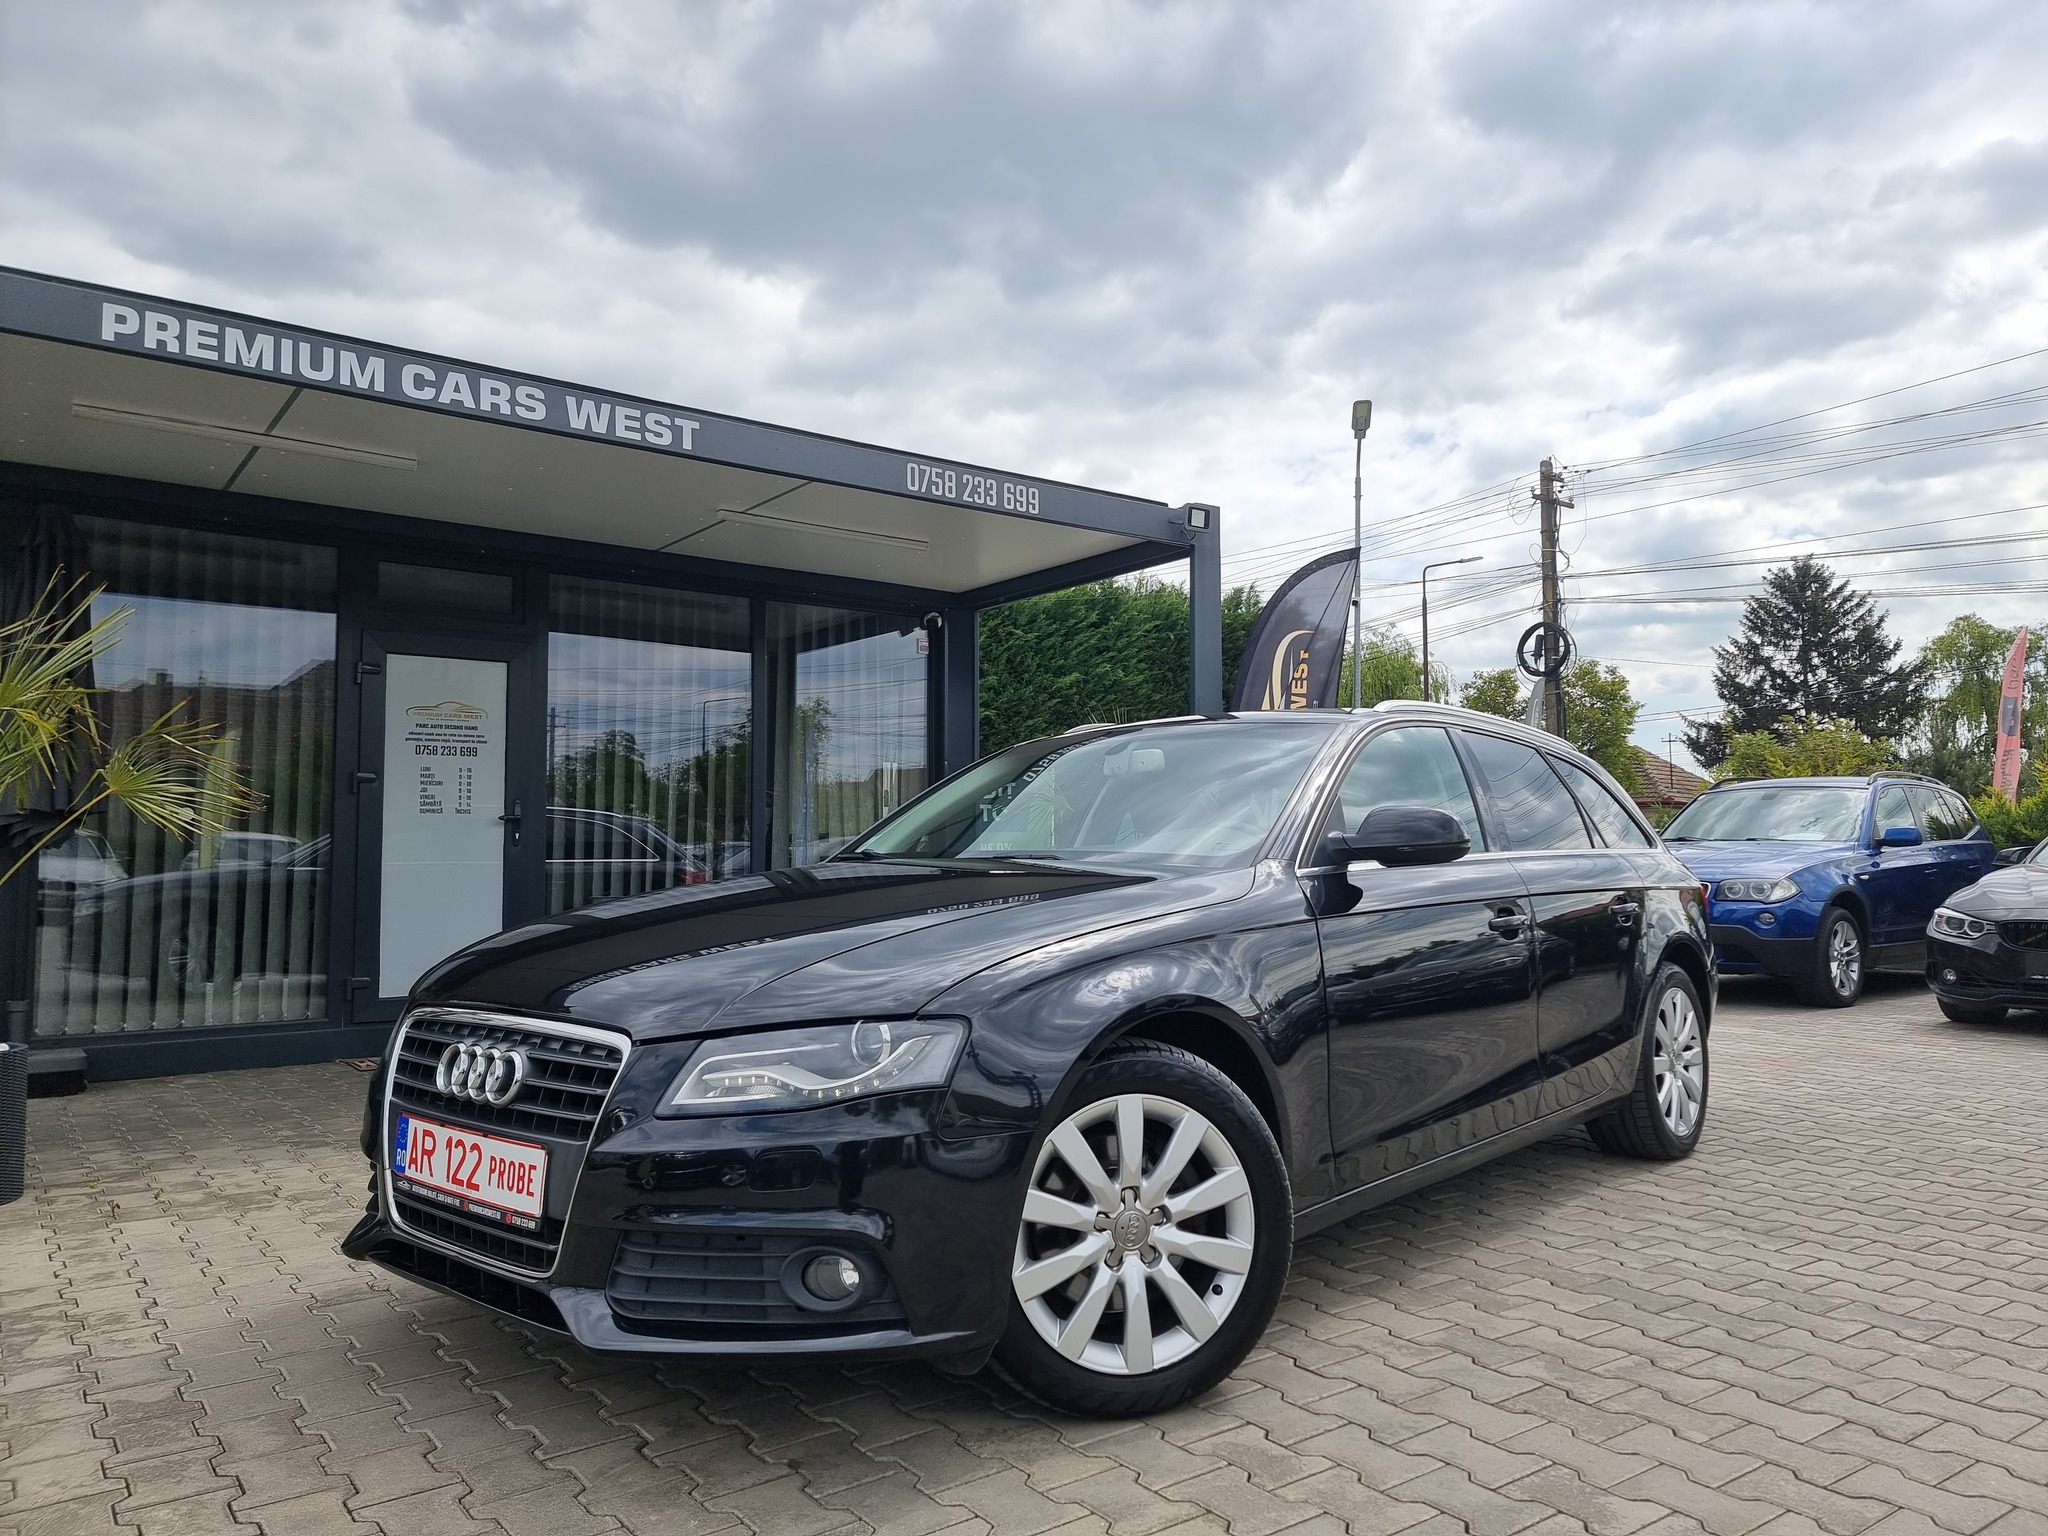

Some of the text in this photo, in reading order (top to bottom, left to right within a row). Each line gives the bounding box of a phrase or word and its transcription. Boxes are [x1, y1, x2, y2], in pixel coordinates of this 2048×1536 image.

[101, 302, 700, 450] PREMIUM CARS WEST
[906, 462, 1039, 514] 0758 233 699
[415, 745, 478, 757] 0758 233 699
[396, 1149, 406, 1167] RO
[408, 1126, 537, 1197] AR 122 PROBE
